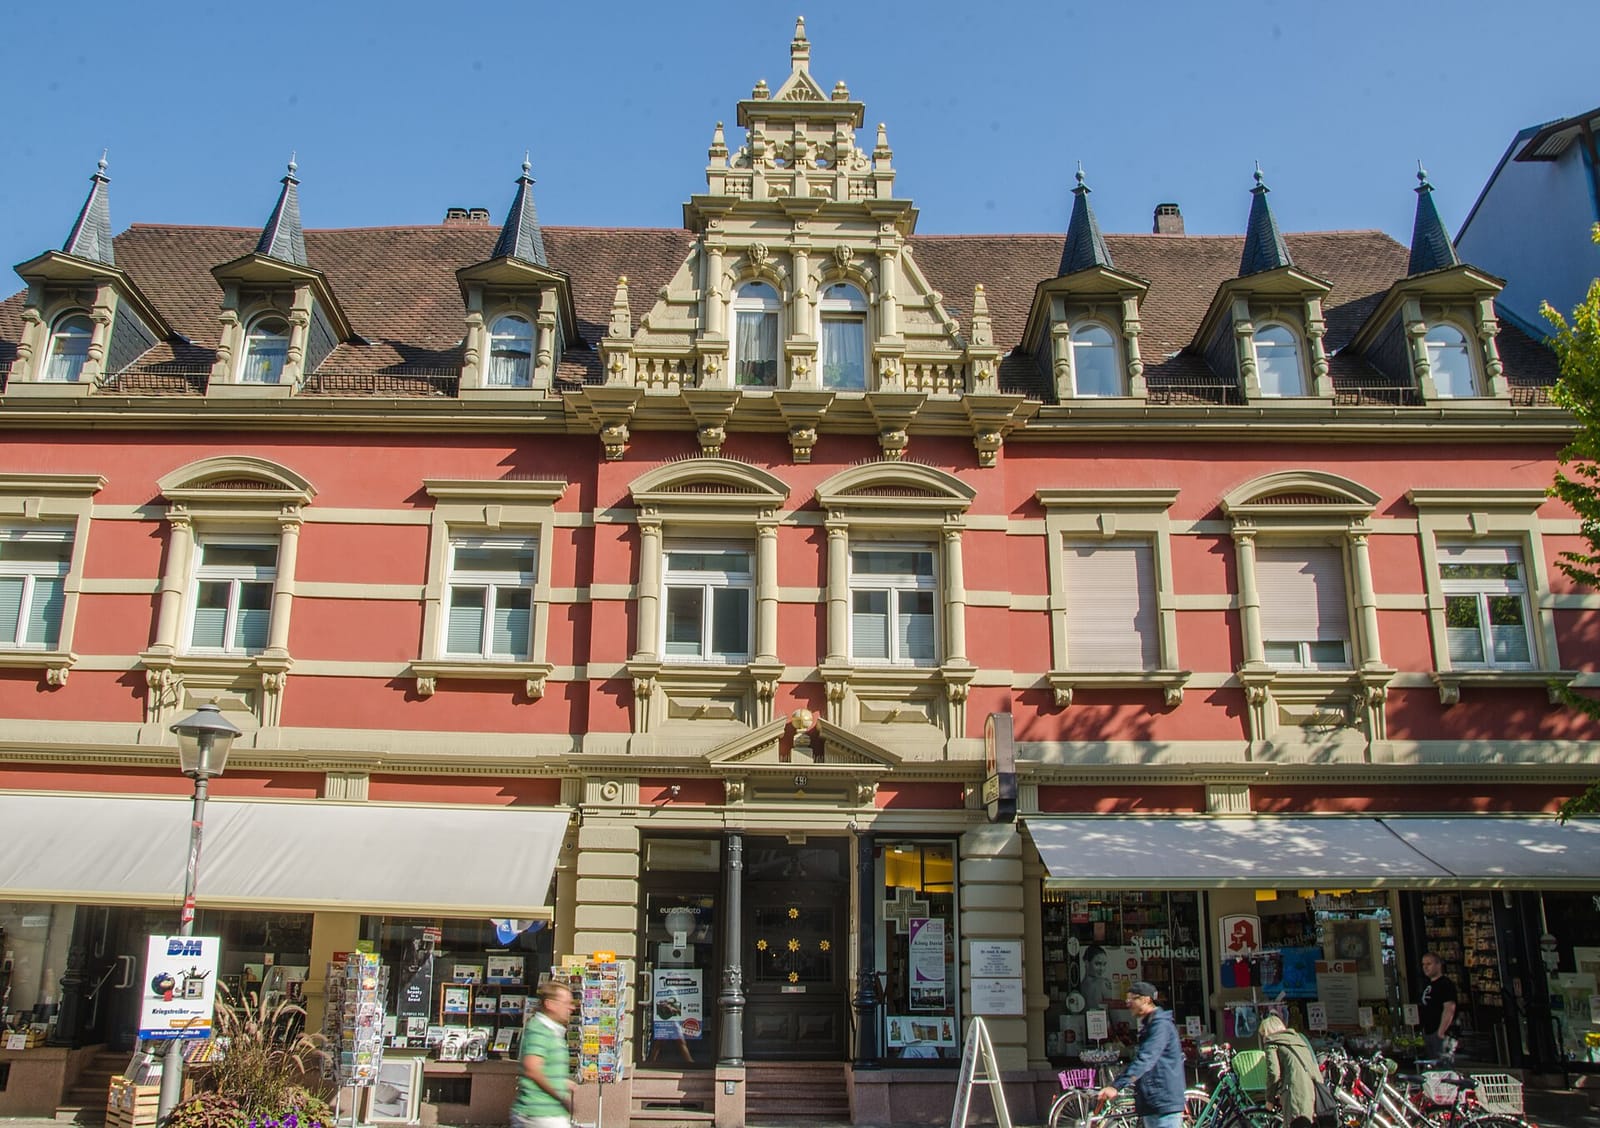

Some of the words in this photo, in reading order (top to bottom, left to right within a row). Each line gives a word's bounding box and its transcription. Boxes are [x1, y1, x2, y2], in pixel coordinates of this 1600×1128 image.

[167, 939, 203, 956] DM
[1130, 936, 1165, 948] Stadt
[1136, 945, 1199, 960] Apotheke
